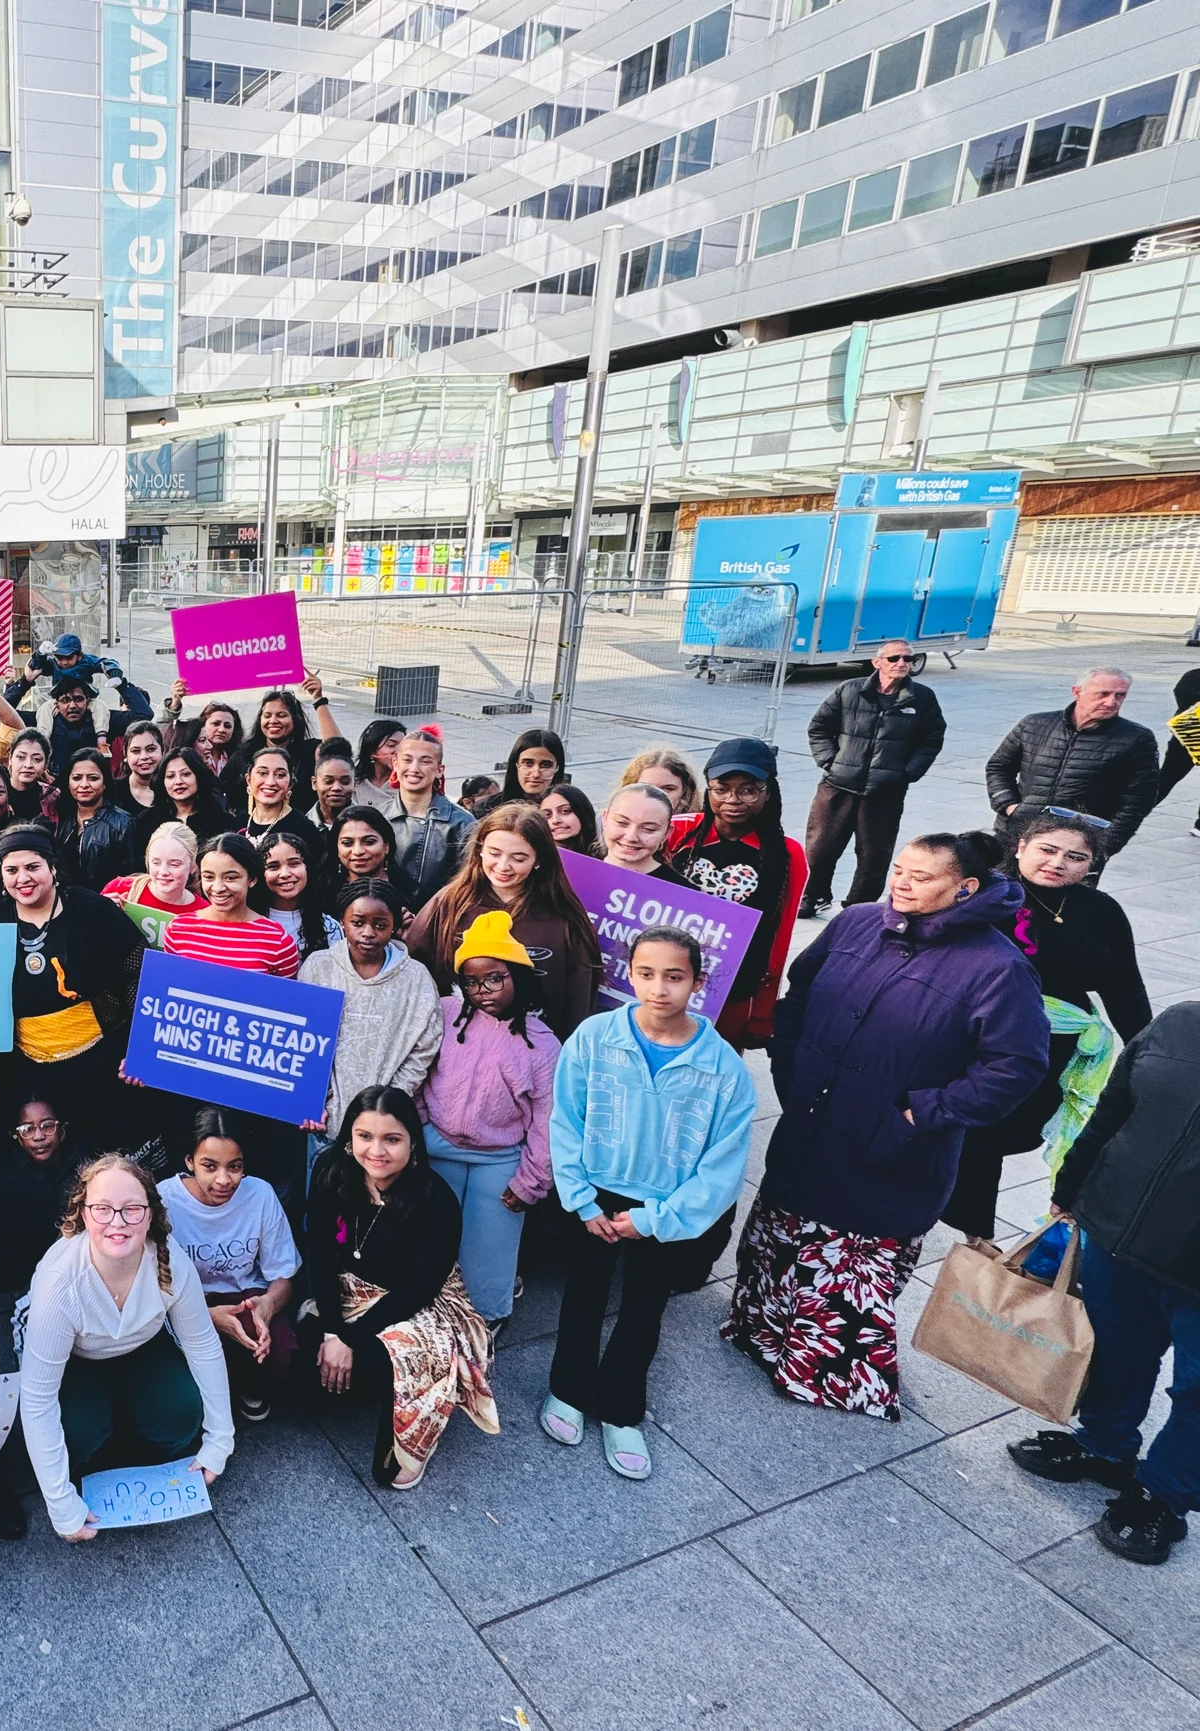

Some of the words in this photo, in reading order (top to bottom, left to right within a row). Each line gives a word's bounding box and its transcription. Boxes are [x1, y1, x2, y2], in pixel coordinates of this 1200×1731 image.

[111, 0, 170, 209] Curve
[112, 233, 166, 365] The
[145, 472, 186, 489] HOUSE
[895, 477, 926, 490] Millions
[926, 477, 950, 489] could
[949, 478, 969, 489] save
[898, 490, 919, 502] with
[918, 489, 944, 502] British
[943, 489, 961, 502] Gas
[71, 517, 110, 530] HALAL
[720, 561, 762, 574] British
[764, 561, 791, 574] Gas
[185, 634, 287, 661] #SLOUGH2028
[604, 888, 733, 950] SLOUGH:
[140, 996, 221, 1032] SLOUGH
[223, 1015, 241, 1037] &
[246, 1019, 331, 1058] STEADY
[153, 1021, 203, 1052] WINS
[206, 1034, 245, 1063] THE
[245, 1043, 306, 1078] RACE
